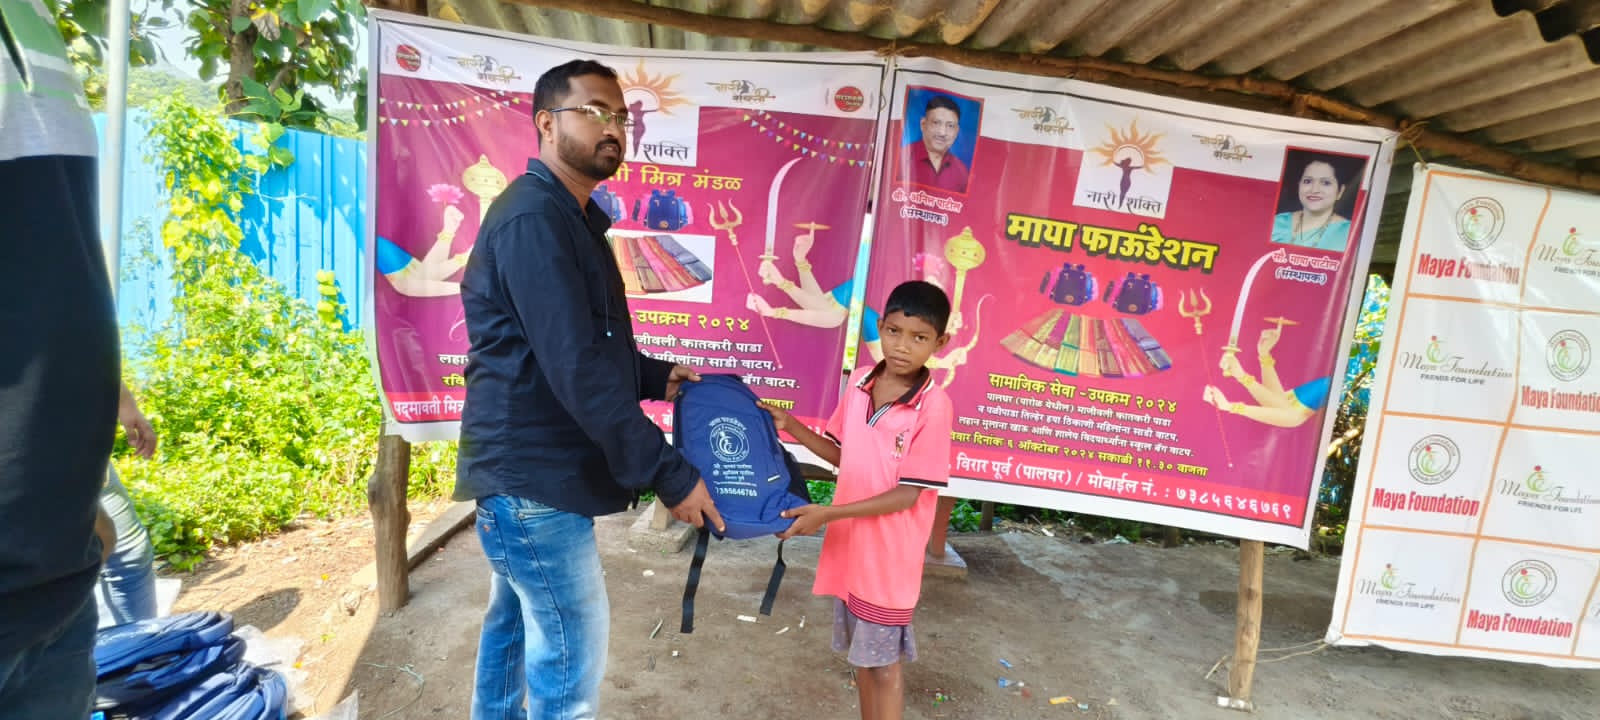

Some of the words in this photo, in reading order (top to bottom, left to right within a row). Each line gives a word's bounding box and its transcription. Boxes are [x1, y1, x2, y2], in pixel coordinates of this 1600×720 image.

[642, 141, 690, 163] शक्ति
[640, 164, 686, 187] मित्र
[691, 168, 743, 191] मंडळ
[1085, 189, 1117, 212] नारी
[1124, 193, 1163, 215] शक्ति
[1006, 213, 1079, 252] माया
[1081, 223, 1220, 273] फाऊंडेशन
[1417, 253, 1457, 279] Maya
[698, 313, 750, 332] २०२४
[632, 332, 677, 348] जीवली
[680, 337, 732, 352] कातकरी
[735, 342, 764, 354] पाडा
[989, 372, 1048, 393] सामाजिक
[1050, 379, 1077, 398] सेवा
[1136, 395, 1178, 413] २०२४
[1521, 385, 1549, 410] Maya
[973, 431, 1005, 447] दिनांक
[1063, 446, 1095, 460] २०२४
[1098, 451, 1134, 466] सकाळी
[956, 452, 989, 474] विरार
[991, 456, 1013, 480] पूर्व
[1015, 463, 1072, 486] (पालघर)
[1087, 470, 1139, 495] मोबाईल
[1372, 487, 1406, 511] Maya
[1407, 490, 1480, 517] Foundation
[1466, 609, 1502, 632] Maya
[1502, 612, 1573, 638] Foundation
